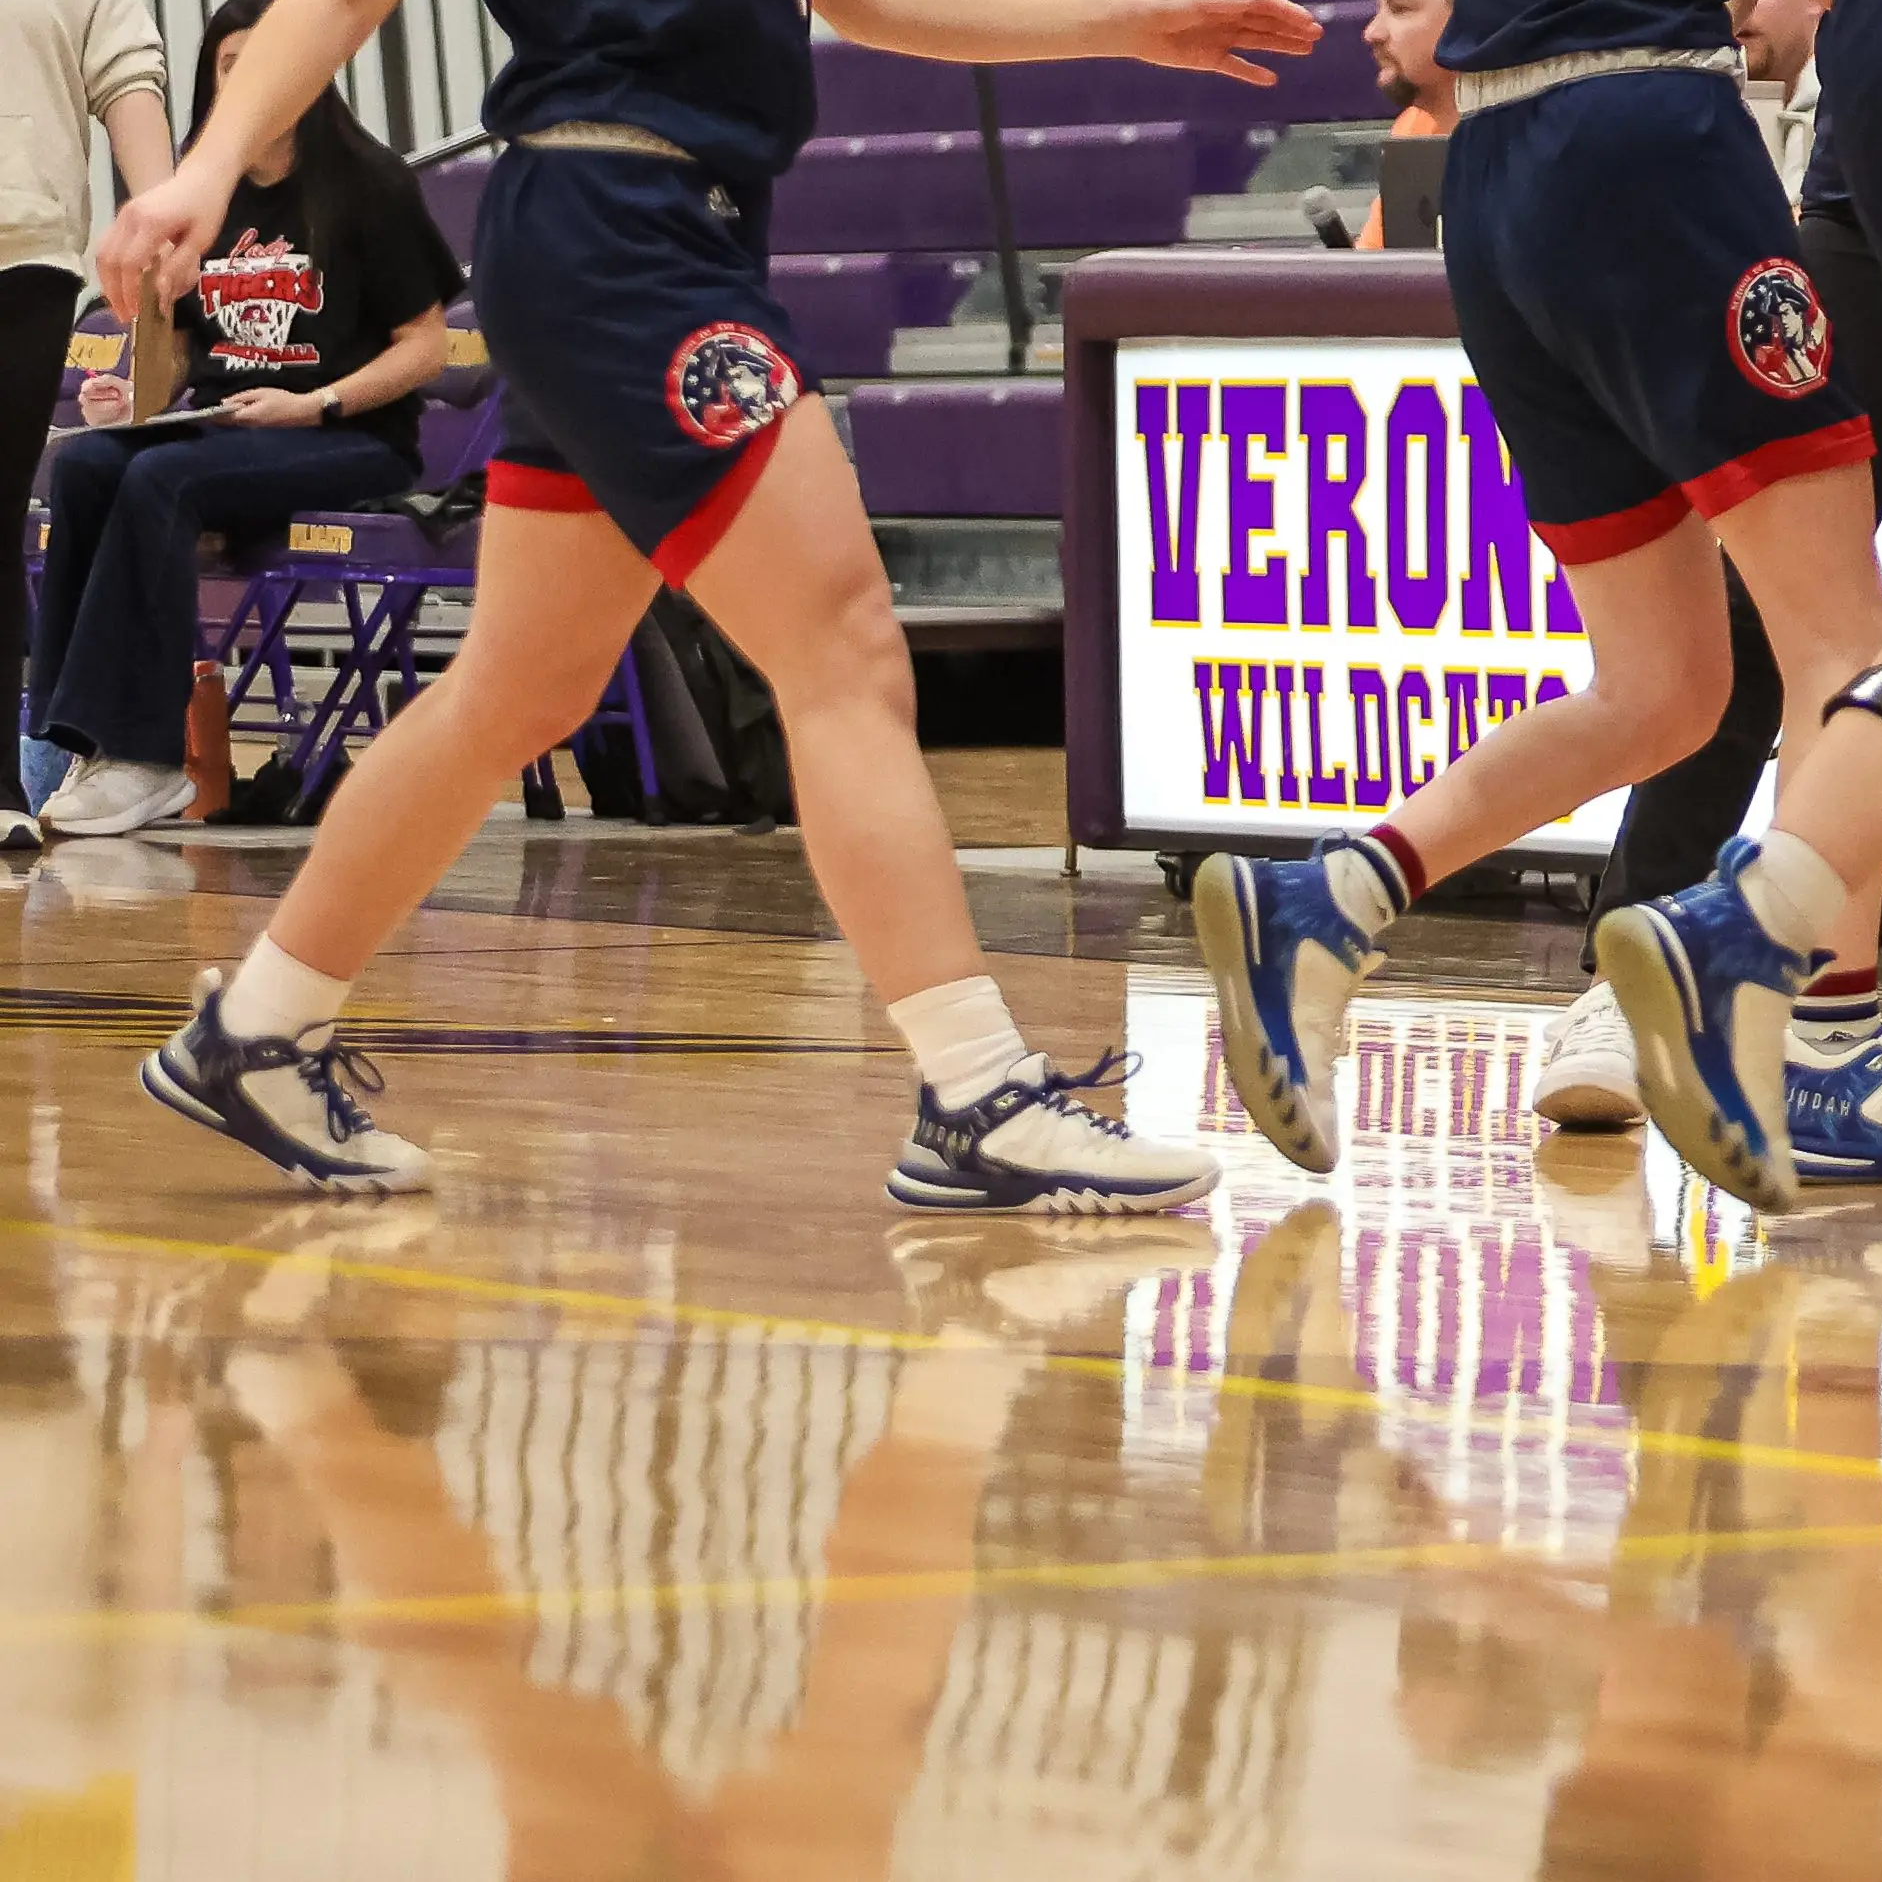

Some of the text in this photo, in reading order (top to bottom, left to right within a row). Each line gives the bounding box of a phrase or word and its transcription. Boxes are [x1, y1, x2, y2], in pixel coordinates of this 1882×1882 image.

[199, 269, 325, 320] TIGERS
[1135, 377, 1590, 640] VERON
[1192, 656, 1574, 815] WILDCA
[1787, 1086, 1850, 1117] JUDAH
